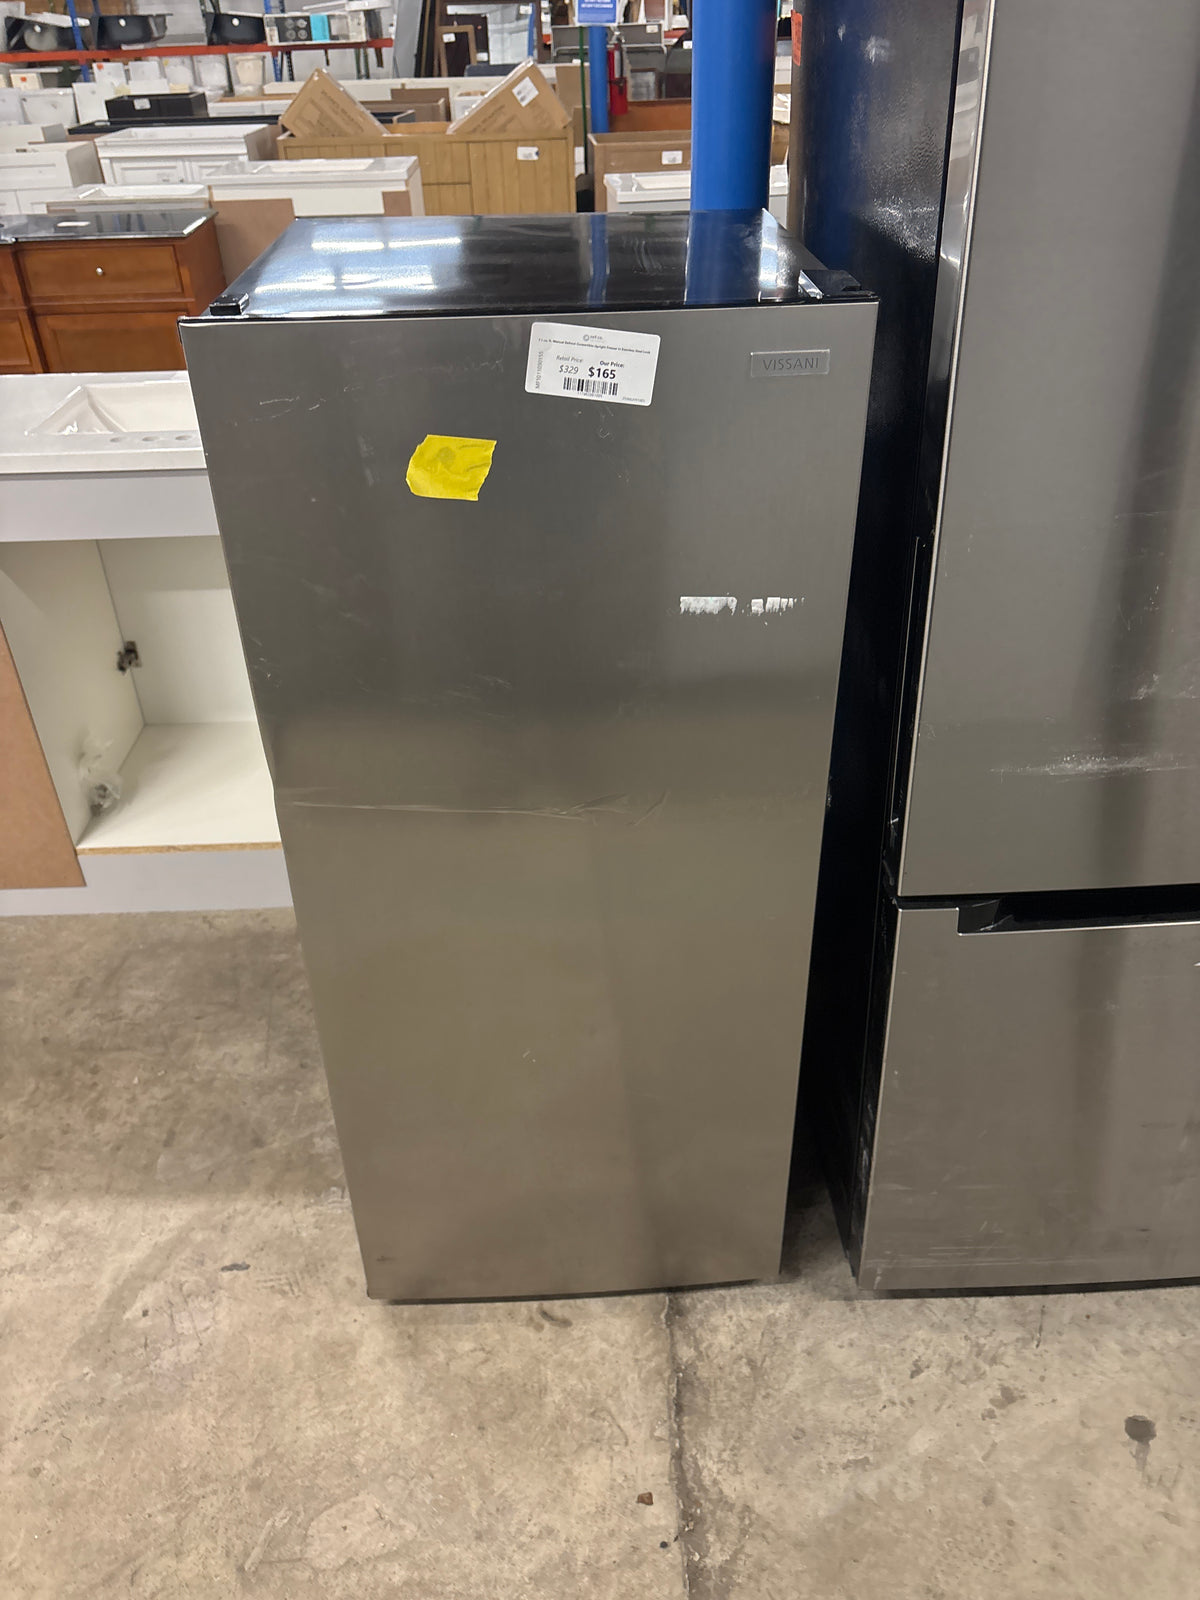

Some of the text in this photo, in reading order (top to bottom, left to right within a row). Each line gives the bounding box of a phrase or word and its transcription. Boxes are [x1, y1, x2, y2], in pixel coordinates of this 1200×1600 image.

[559, 364, 578, 374] $329
[762, 358, 818, 370] VISSANI
[588, 366, 616, 379] $165
